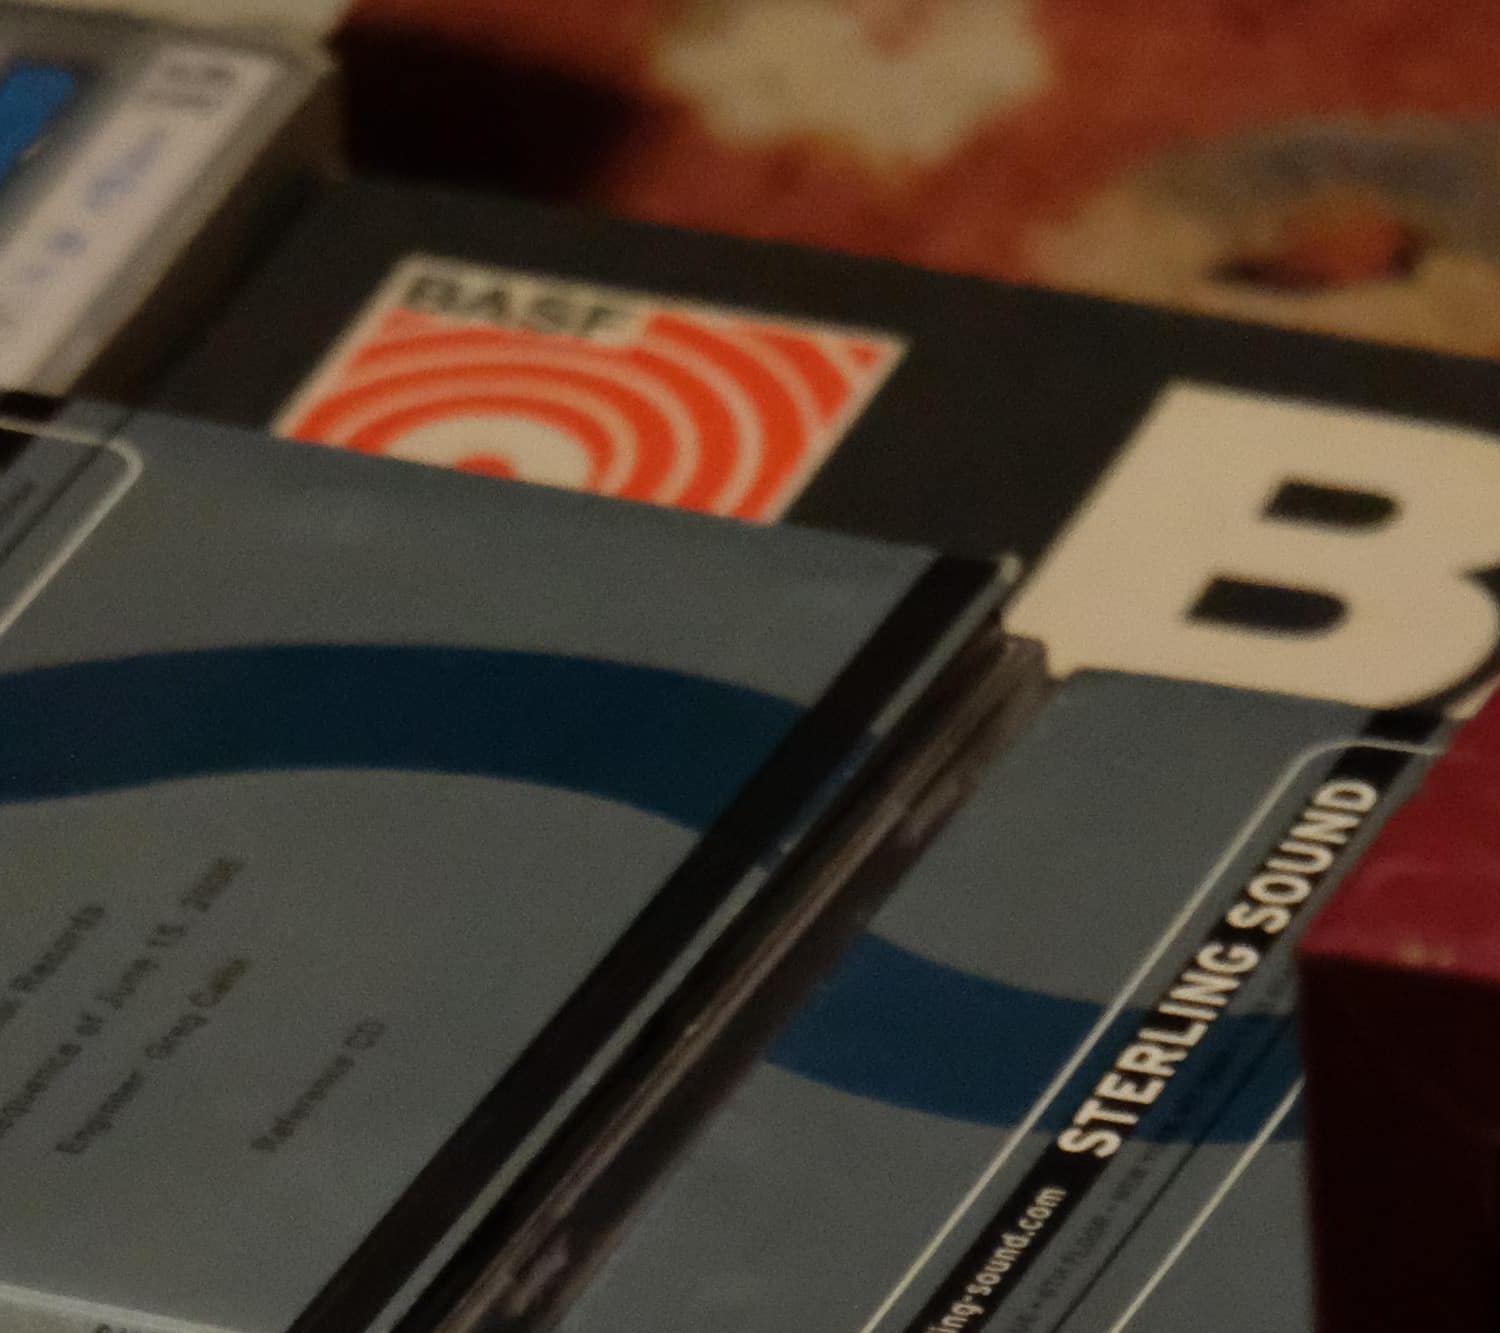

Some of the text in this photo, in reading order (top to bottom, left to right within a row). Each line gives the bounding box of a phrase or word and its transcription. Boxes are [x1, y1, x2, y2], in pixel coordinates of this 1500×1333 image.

[401, 271, 648, 341] BASF
[1058, 778, 1379, 1160] STERLING SOUND
